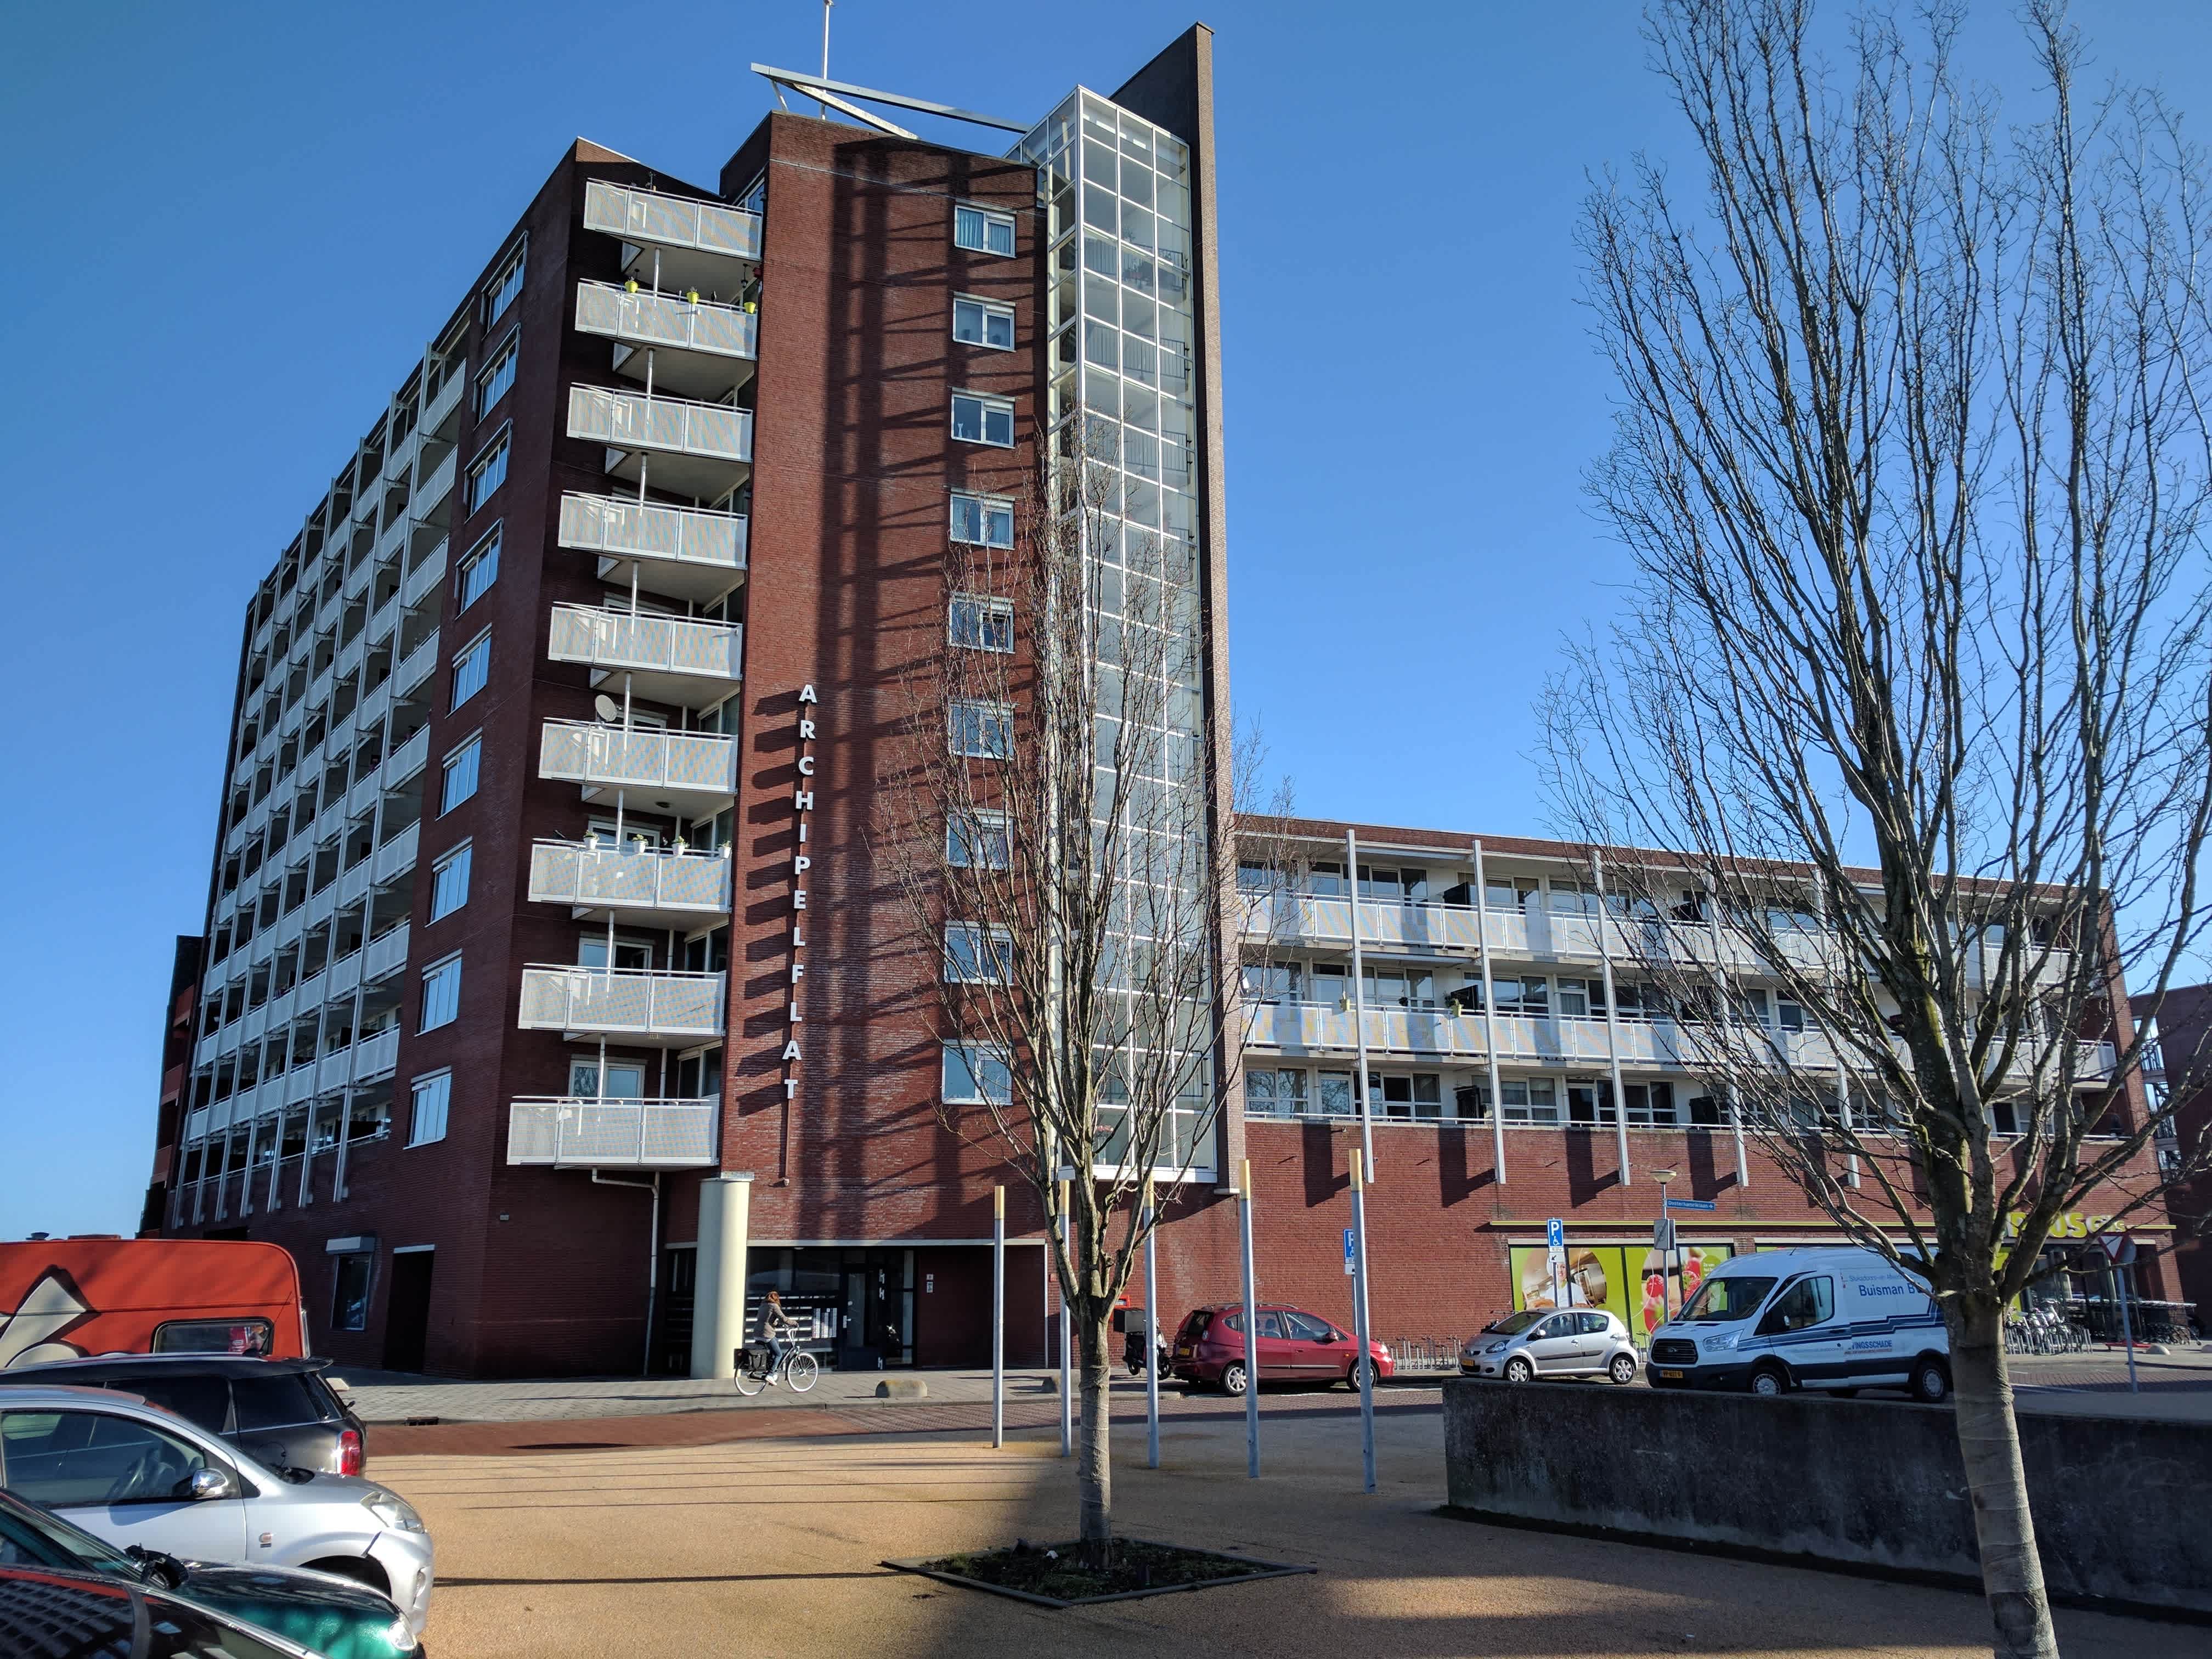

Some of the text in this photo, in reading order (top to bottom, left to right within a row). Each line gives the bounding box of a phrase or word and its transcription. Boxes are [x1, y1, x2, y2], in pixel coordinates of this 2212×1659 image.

[782, 684, 817, 1099] ARCHIPELFLAT
[2007, 1211, 2088, 1238] PUS
[1859, 1284, 1904, 1296] Buisman
